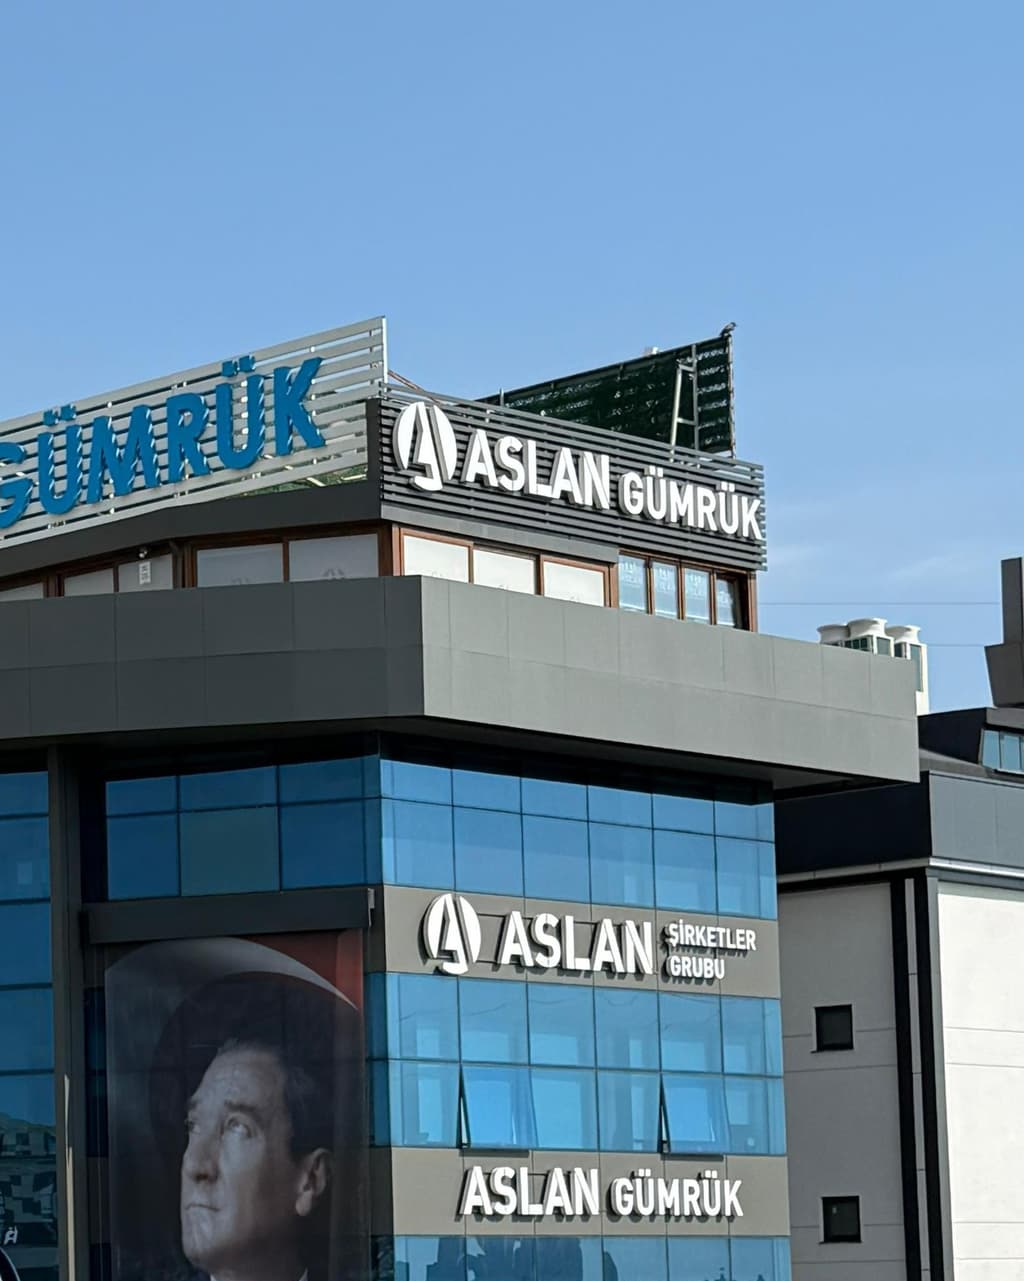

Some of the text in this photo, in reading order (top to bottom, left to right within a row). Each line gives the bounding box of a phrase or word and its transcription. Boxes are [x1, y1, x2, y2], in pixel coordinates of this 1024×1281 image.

[465, 429, 762, 539] ASLAN GÜMRÜK
[500, 911, 756, 974] ASLAN ŞİRKETLER
[668, 954, 726, 980] GRUBU
[462, 1166, 744, 1216] ASLAN GÜMRÜK
